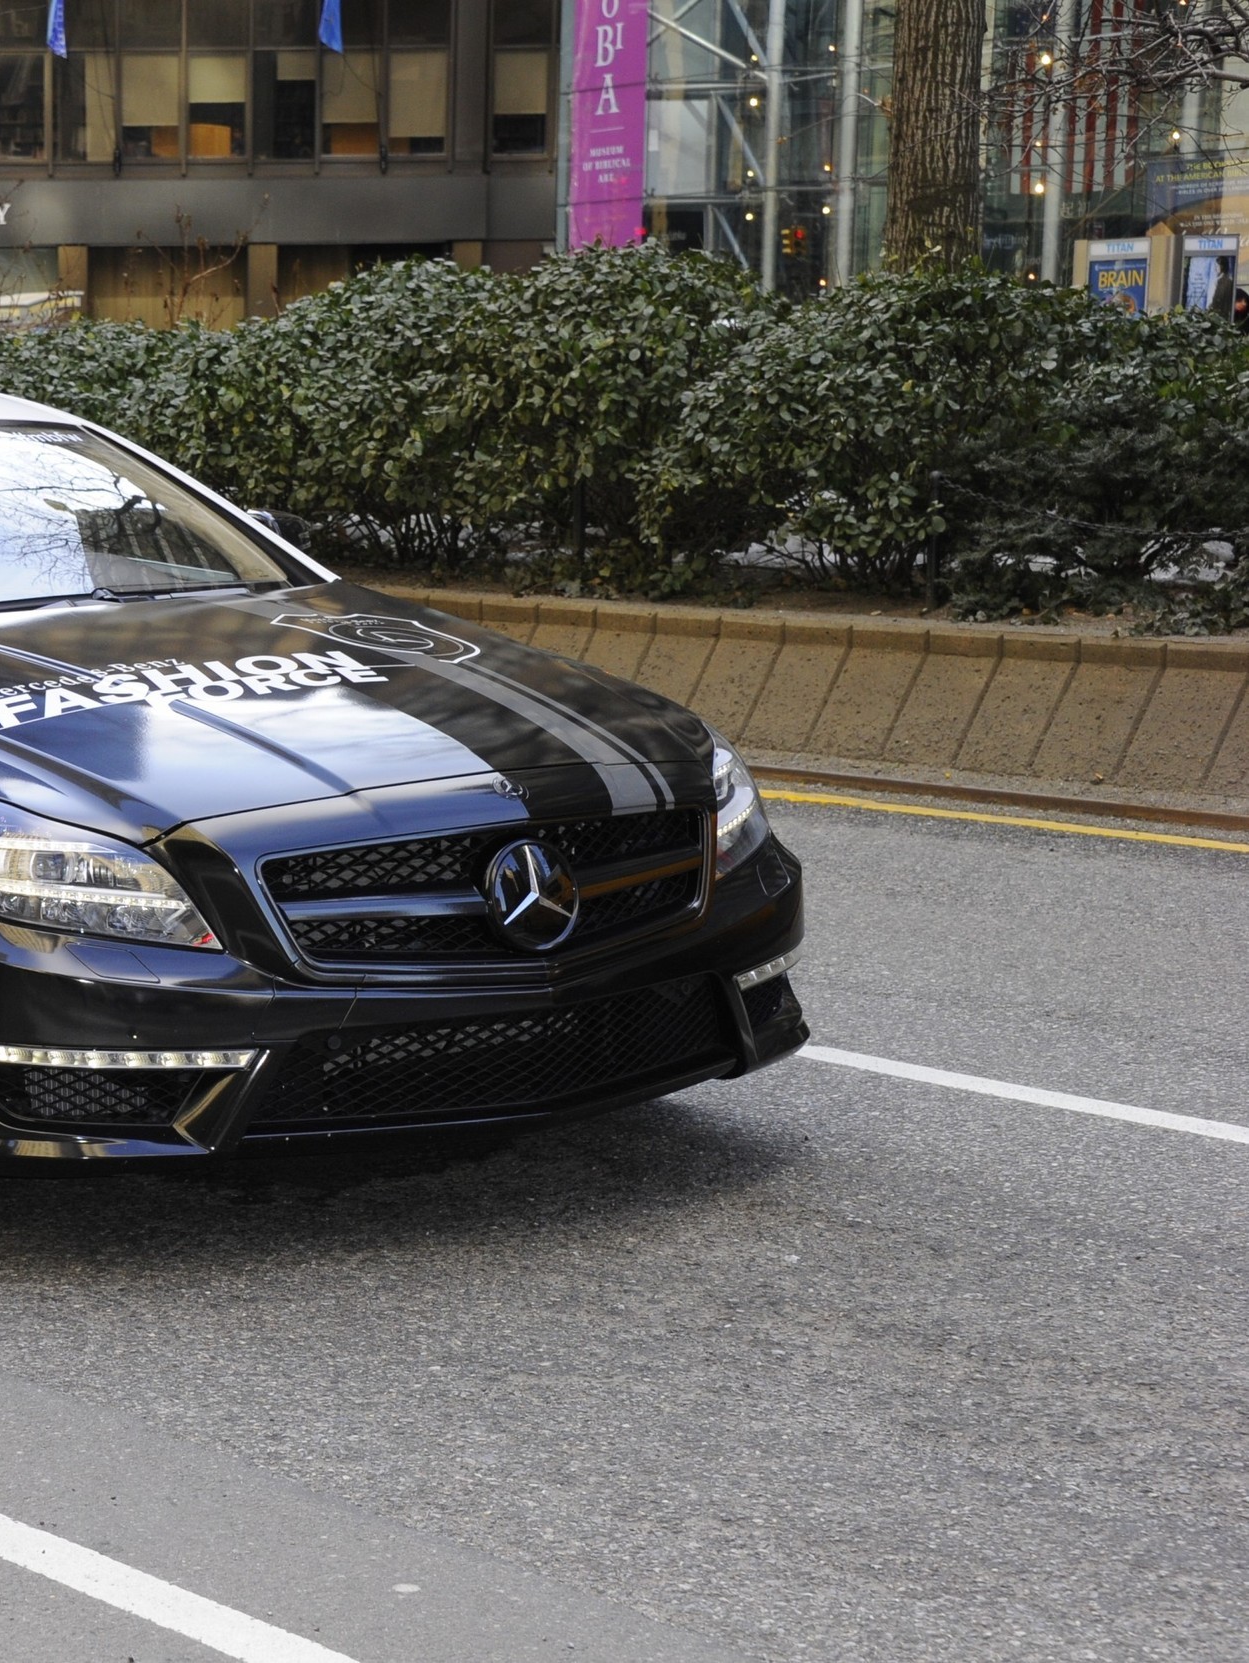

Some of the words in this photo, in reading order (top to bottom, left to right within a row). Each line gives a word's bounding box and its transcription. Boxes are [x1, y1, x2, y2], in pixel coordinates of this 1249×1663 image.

[590, 145, 624, 157] MUSEUM
[582, 160, 593, 171] OF
[595, 158, 631, 170] BIBLICAL
[1105, 243, 1134, 253] TITAN
[1198, 239, 1223, 249] TITAN
[1098, 269, 1144, 289] BRAIN
[146, 667, 389, 712] FORCE
